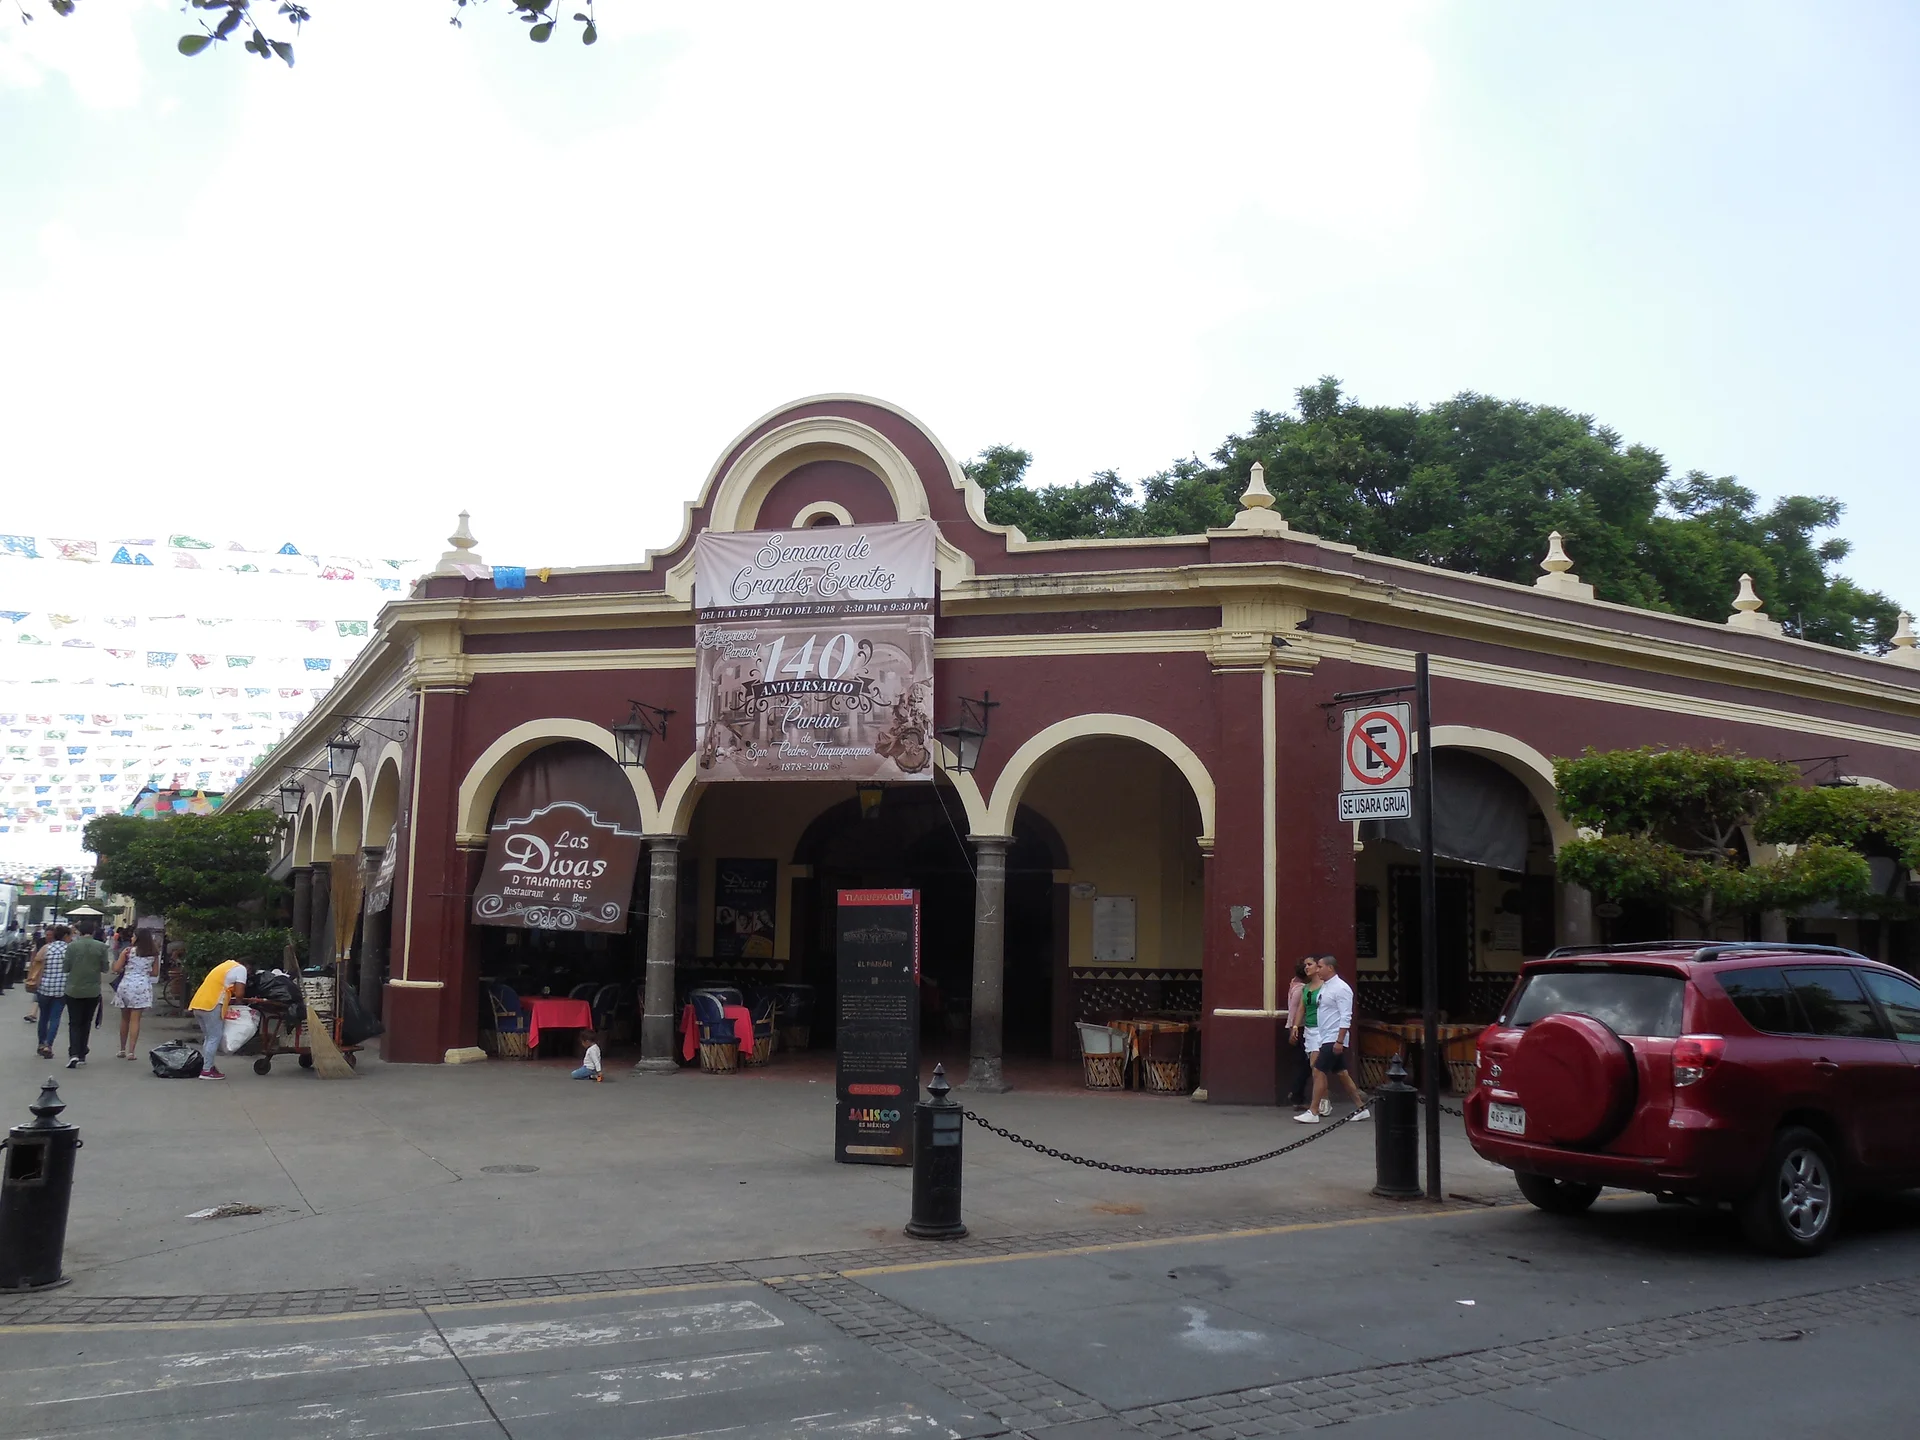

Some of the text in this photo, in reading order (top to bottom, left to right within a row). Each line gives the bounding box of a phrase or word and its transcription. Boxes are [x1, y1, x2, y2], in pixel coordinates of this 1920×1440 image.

[754, 533, 871, 570] Semana de
[730, 560, 896, 603] Grandes Eventos
[701, 611, 716, 620] DEL
[717, 610, 724, 619] 11
[725, 610, 737, 618] AL
[739, 609, 748, 617] 15
[749, 608, 762, 617] DE
[764, 607, 792, 617] JULIO
[794, 606, 812, 614] DEL
[814, 605, 835, 614] 2018
[843, 604, 864, 613] 3:30
[865, 603, 881, 612] PM
[882, 605, 888, 613] y
[889, 603, 911, 611] 9:30
[912, 602, 929, 611] PM
[764, 633, 855, 683] 140
[760, 680, 854, 697] ANIVERSARIO
[768, 700, 841, 741] Parián
[801, 732, 811, 743] de
[746, 742, 768, 761] San
[810, 740, 872, 760] Tlaquepaque
[780, 763, 829, 771] 1878-2018
[1343, 796, 1407, 814] SE USARA GRUA
[554, 830, 589, 849] Las
[499, 833, 608, 877] Divas
[721, 871, 769, 889] Divas
[503, 886, 588, 903] Restaurant & Bar
[848, 1108, 901, 1122] JALISCO
[866, 1121, 890, 1129] MÉXICO
